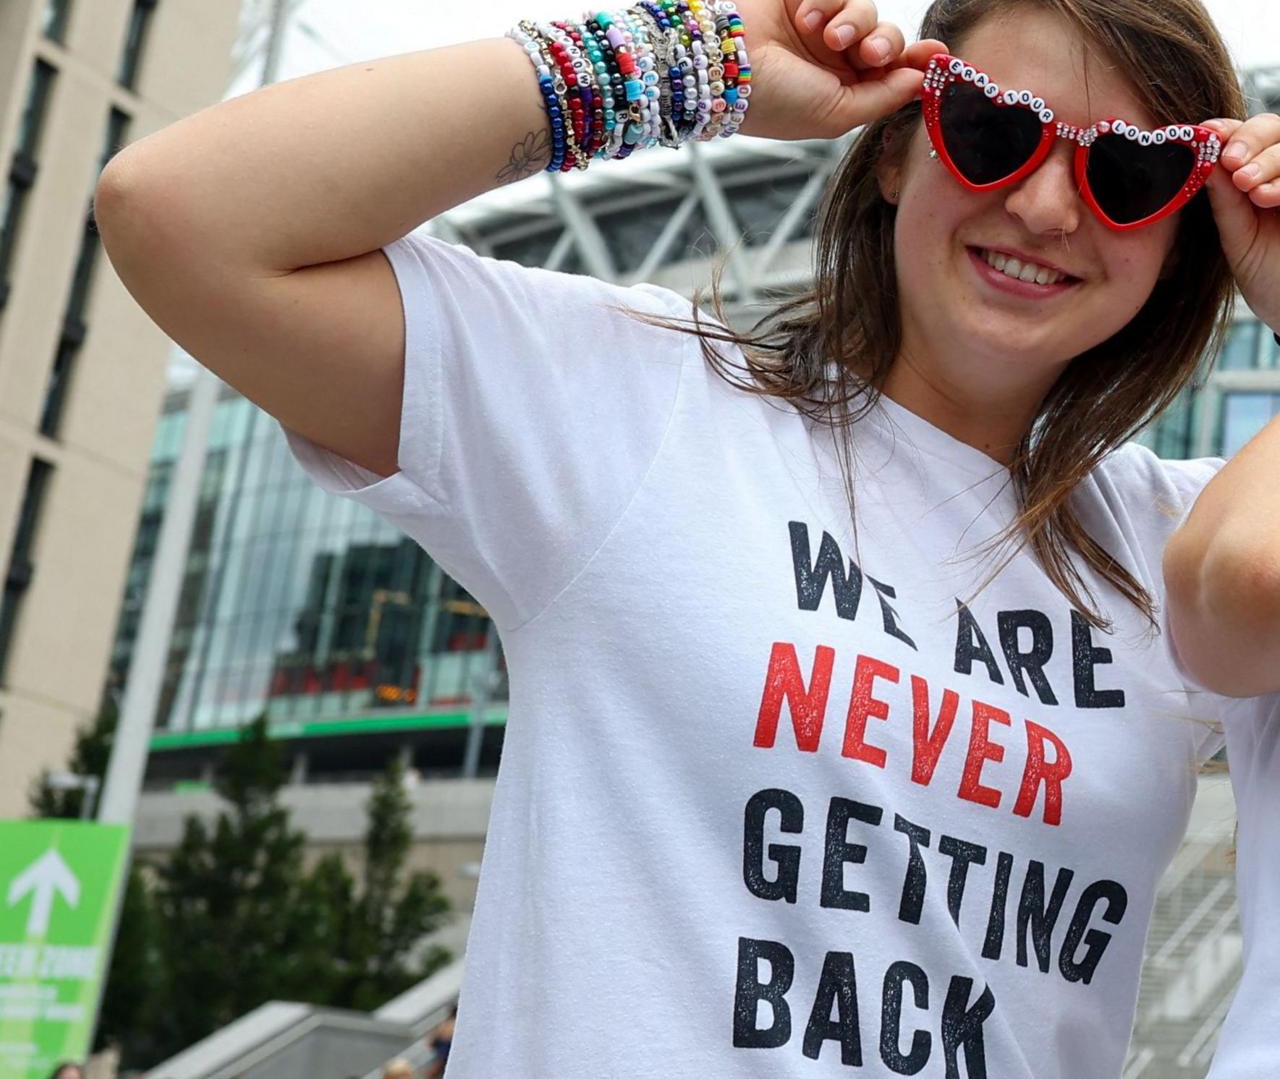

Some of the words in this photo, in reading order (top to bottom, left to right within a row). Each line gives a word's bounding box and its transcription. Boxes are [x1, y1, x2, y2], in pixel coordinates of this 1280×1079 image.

[949, 59, 997, 98] ERAS
[1004, 89, 1053, 122] TOUR
[1112, 119, 1194, 146] LONDON
[788, 521, 918, 651] WE
[953, 597, 1125, 709] ARE
[753, 642, 1073, 827] NEVER
[742, 787, 1129, 985] GETTING
[732, 936, 997, 1079] BACK
